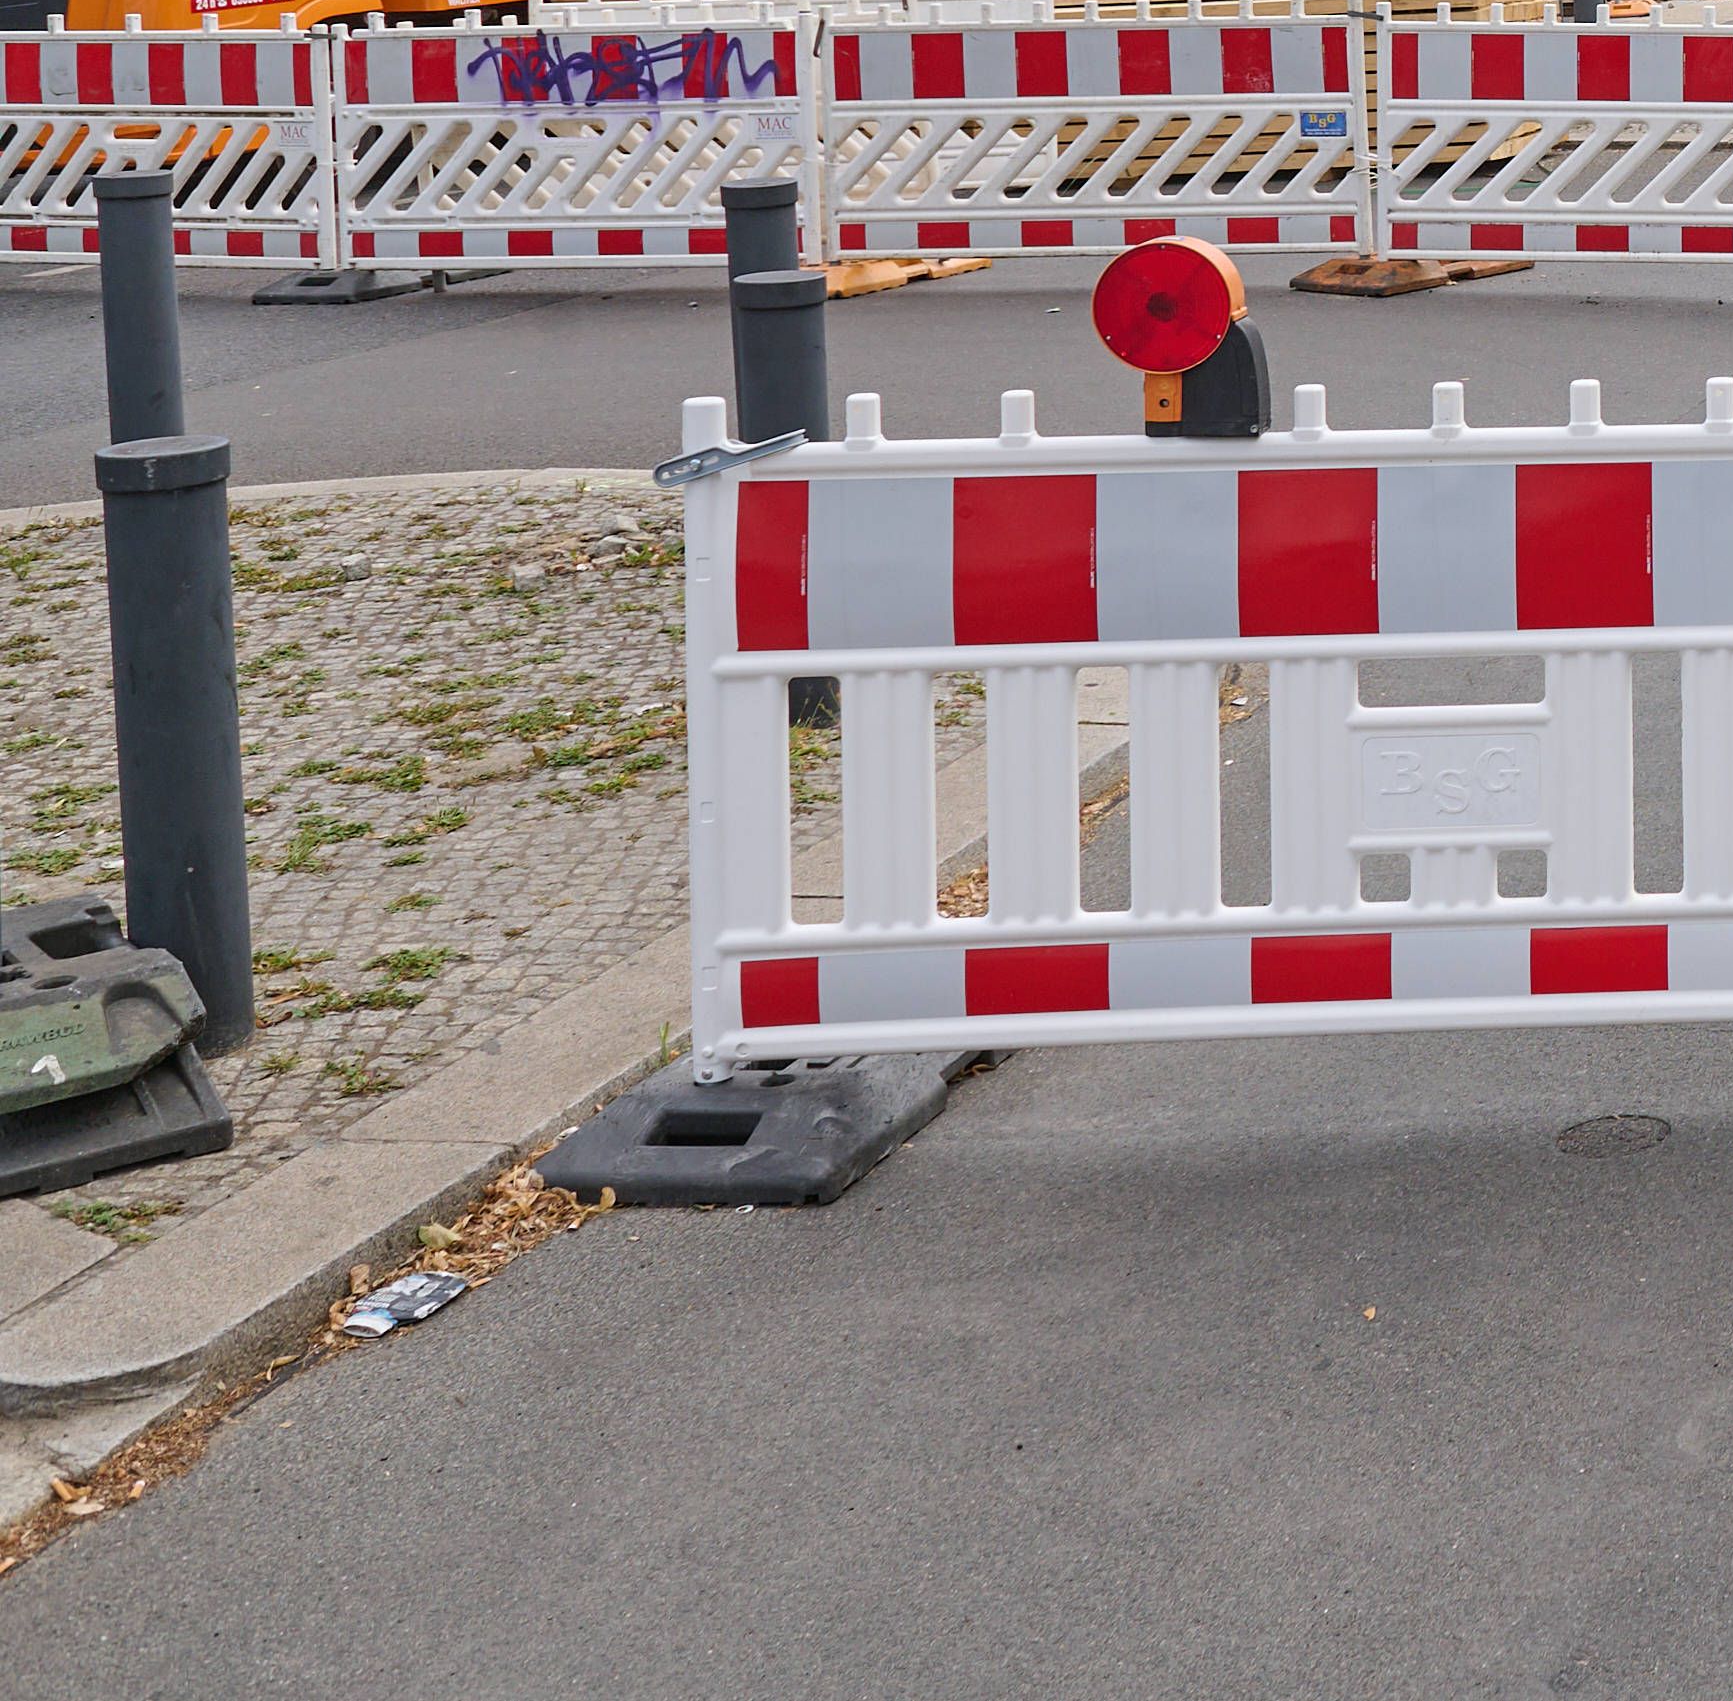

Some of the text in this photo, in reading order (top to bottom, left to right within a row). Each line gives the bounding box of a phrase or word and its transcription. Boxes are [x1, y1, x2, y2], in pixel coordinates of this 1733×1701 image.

[757, 116, 792, 131] MAC
[280, 126, 308, 139] MAC
[1379, 747, 1521, 815] BSG
